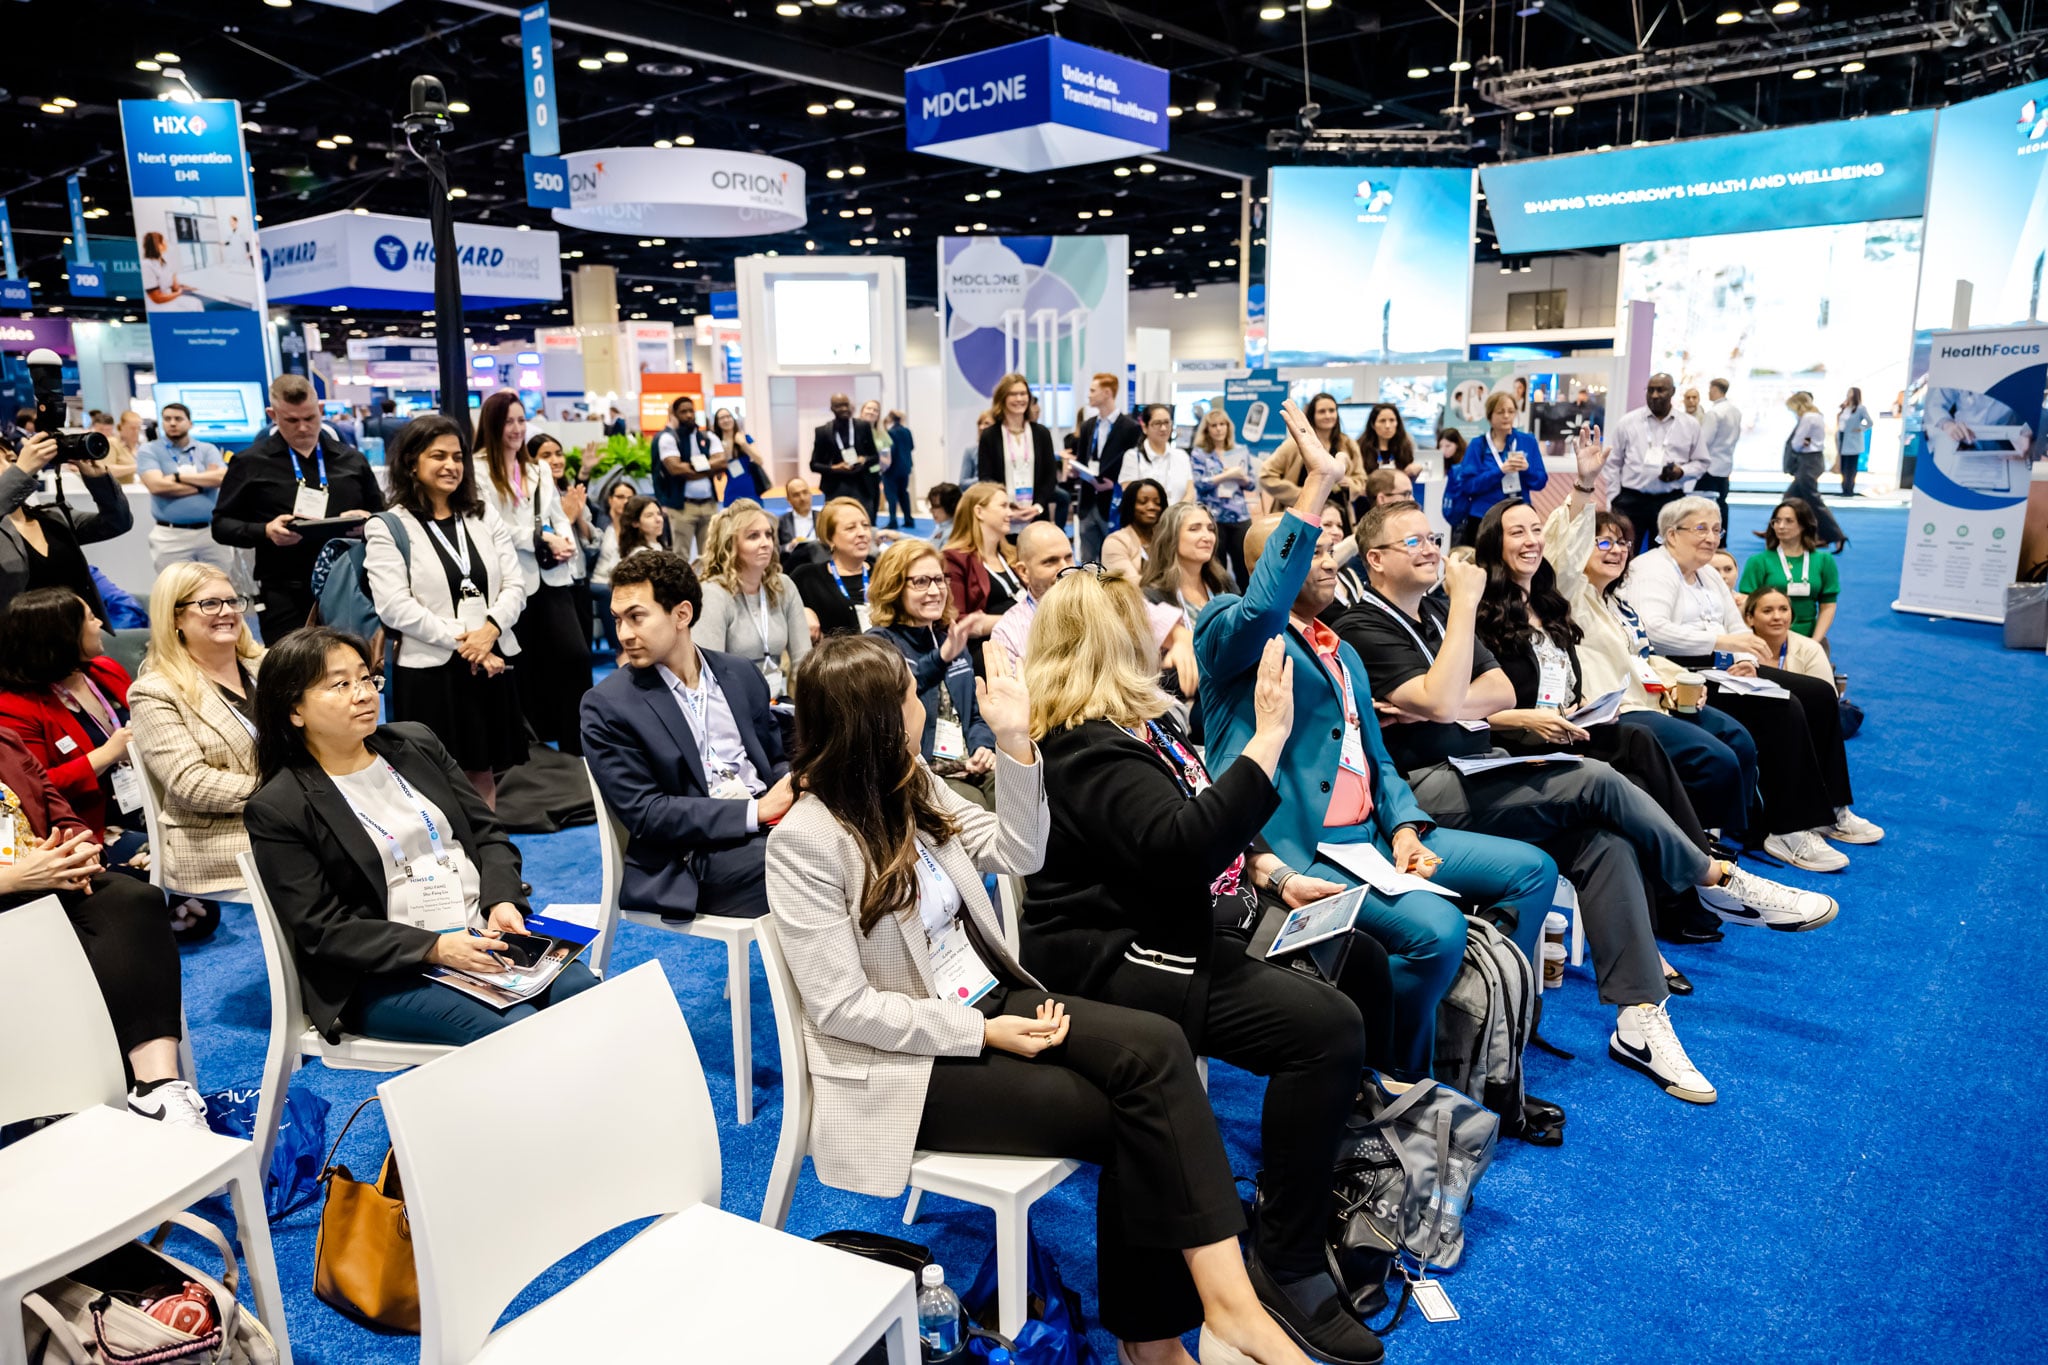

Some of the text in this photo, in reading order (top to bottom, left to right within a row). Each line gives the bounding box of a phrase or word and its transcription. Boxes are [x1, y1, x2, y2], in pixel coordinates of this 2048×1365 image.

[1062, 64, 1120, 95] Unlock data.
[922, 74, 1027, 120] MDCLONE
[1062, 83, 1158, 124] Transform healthcare
[153, 115, 188, 134] HiX
[137, 151, 233, 167] Next generation
[175, 169, 200, 182] EHR
[533, 172, 564, 192] 500
[711, 170, 783, 197] ORION
[1524, 162, 1885, 214] SHAPING TOMORROW'S HEALTH AND WELLBEING
[272, 240, 317, 268] HOWARD
[413, 241, 504, 267] HOARD
[75, 274, 99, 287] 700
[1941, 343, 2040, 358] HealthFocus
[420, 810, 436, 832] HIMSS
[919, 848, 937, 873] HIMSS
